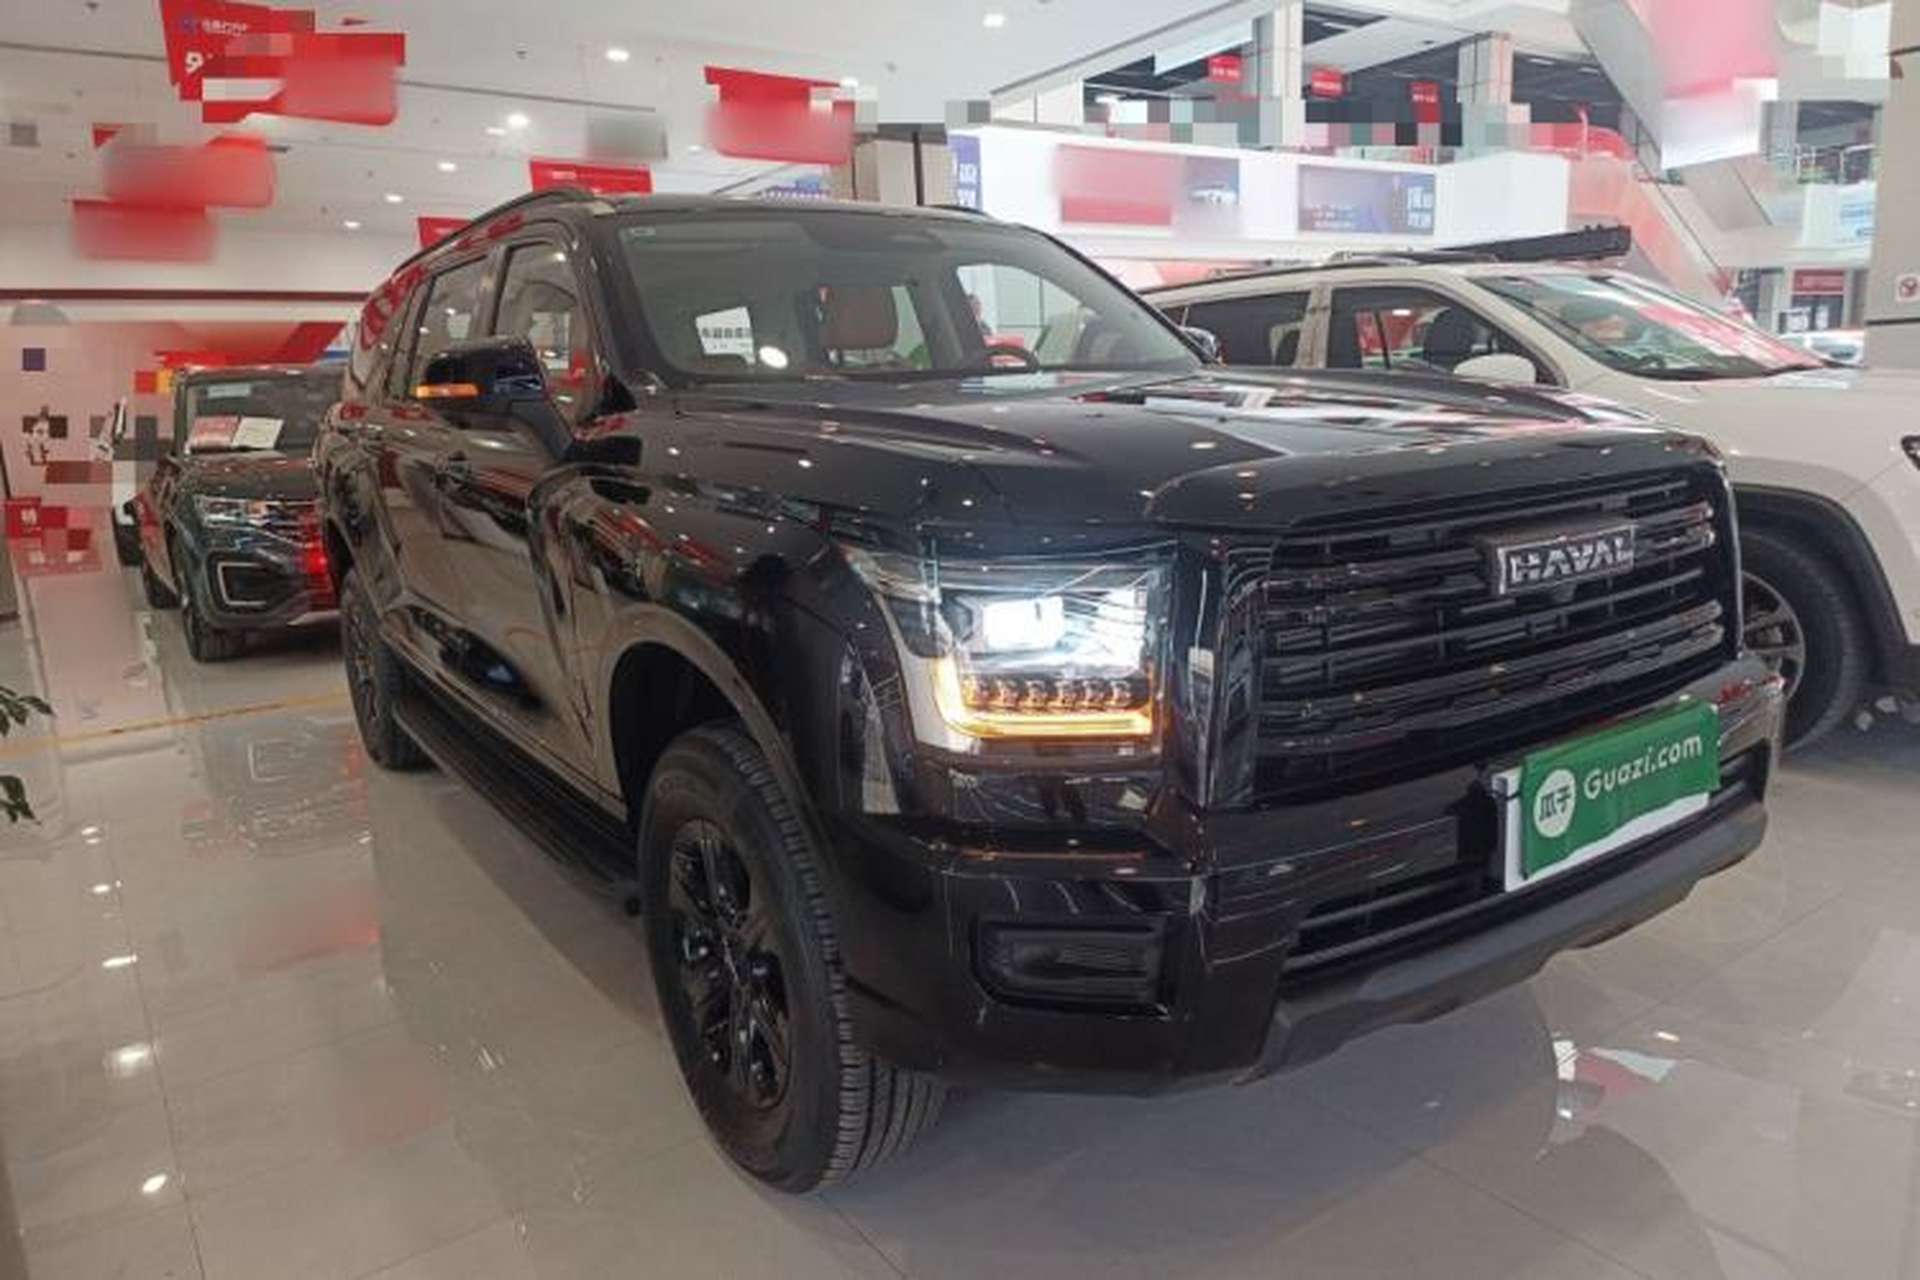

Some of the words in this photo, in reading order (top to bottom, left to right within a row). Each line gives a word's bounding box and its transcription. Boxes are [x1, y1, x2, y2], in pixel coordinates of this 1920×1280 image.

[1510, 536, 1634, 584] HAVAL
[1583, 735, 1702, 800] Guazi.com
[1539, 785, 1571, 823] 瓜子
